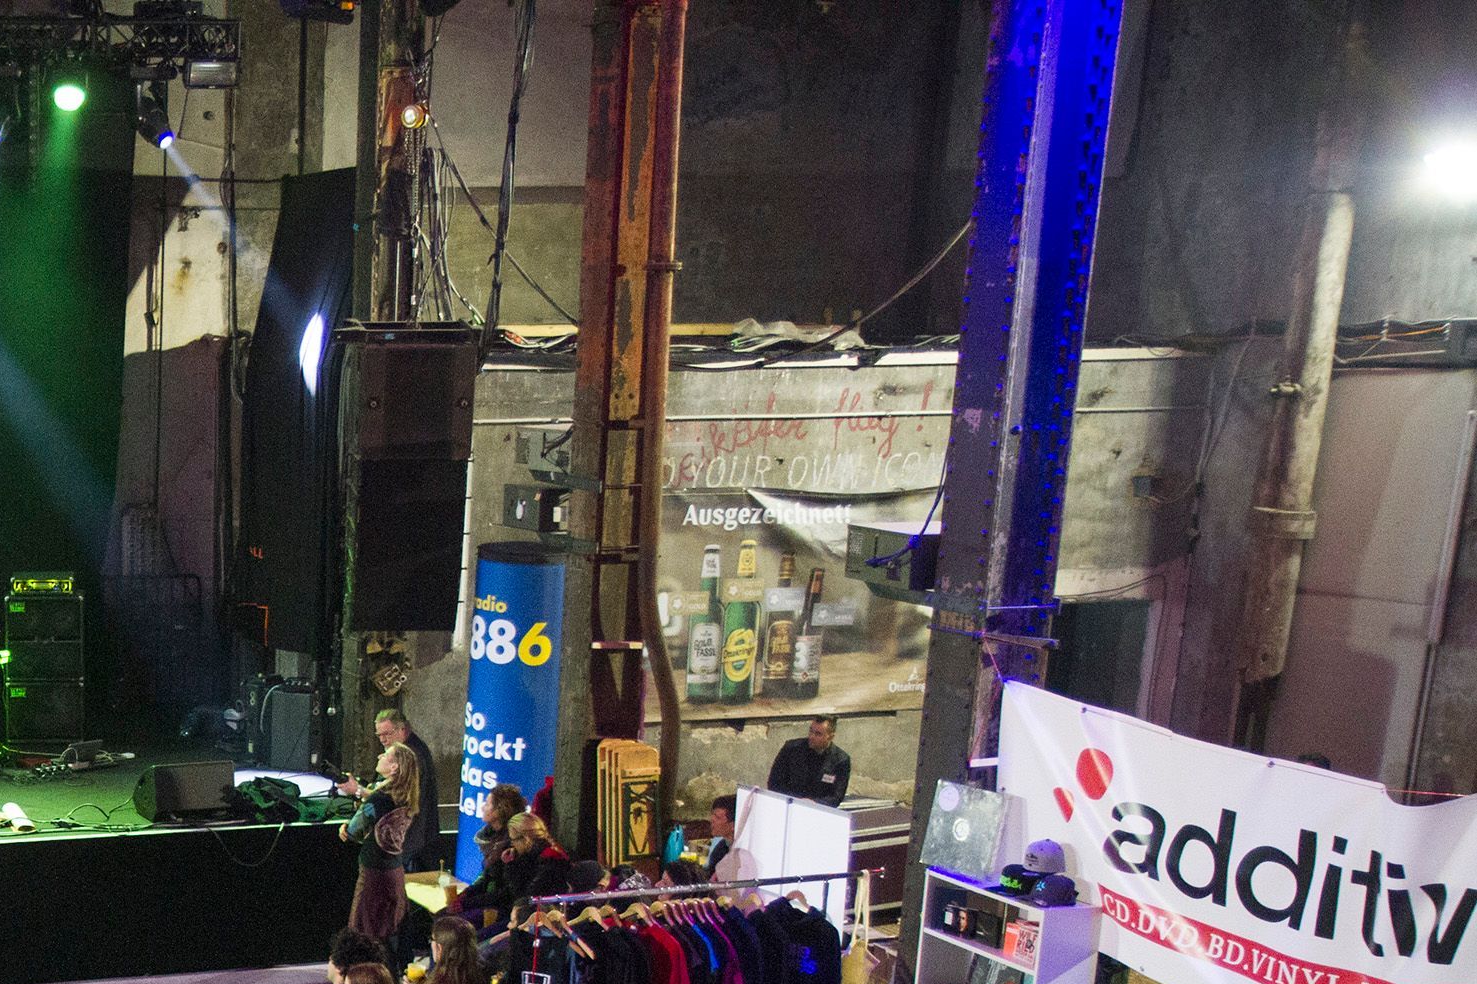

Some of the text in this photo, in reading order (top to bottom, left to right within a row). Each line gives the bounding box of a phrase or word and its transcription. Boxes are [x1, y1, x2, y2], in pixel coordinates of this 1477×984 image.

[682, 503, 853, 531] Ausgezeichnet!
[465, 702, 485, 731] So
[463, 733, 525, 761] rockt
[461, 764, 497, 789] das
